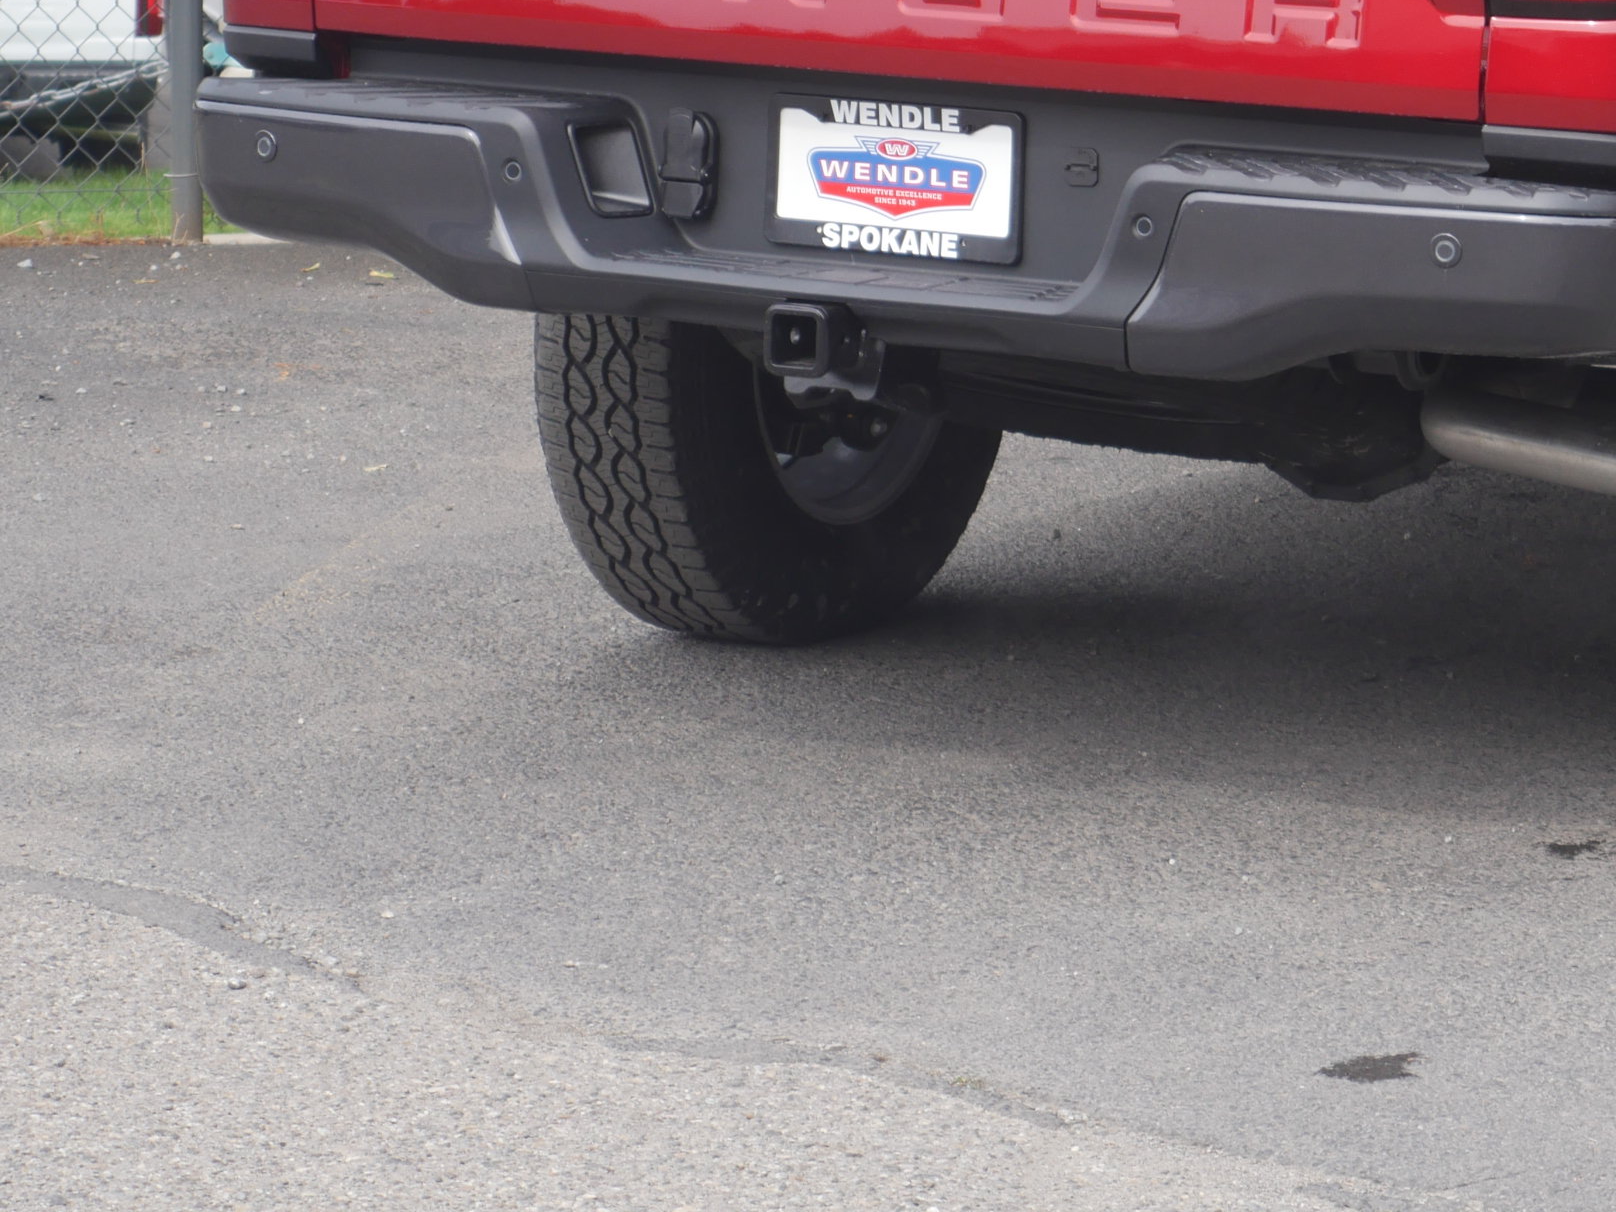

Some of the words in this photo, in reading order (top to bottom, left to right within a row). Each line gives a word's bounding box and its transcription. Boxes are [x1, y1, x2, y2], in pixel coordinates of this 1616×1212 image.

[830, 99, 960, 132] WENDLE
[819, 158, 969, 189] WENDLE
[846, 185, 894, 197] AUTOMOTIVE
[895, 189, 942, 201] EXCELLENCE
[874, 196, 897, 205] SINCE
[822, 222, 959, 259] SPOKANE
